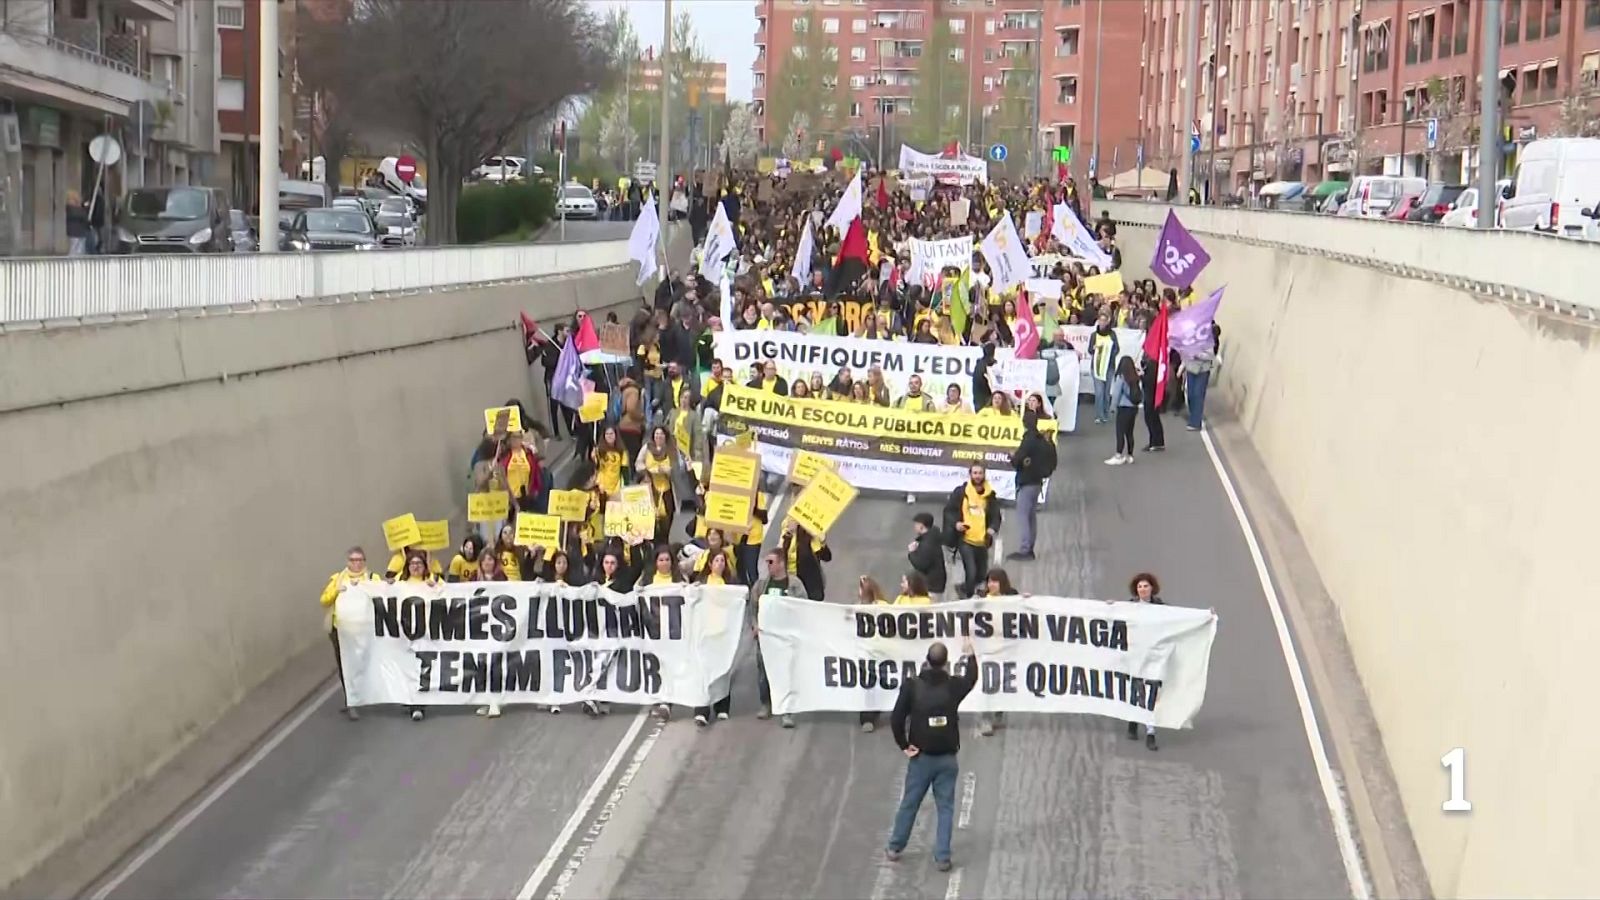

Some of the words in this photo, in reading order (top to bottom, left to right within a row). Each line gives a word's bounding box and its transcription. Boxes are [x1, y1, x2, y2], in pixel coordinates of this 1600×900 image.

[734, 340, 904, 371] DIGNIFIQUEM
[914, 355, 979, 377] L'EDU
[726, 394, 757, 412] PER
[761, 400, 796, 419] UNA
[801, 407, 868, 428] ESCOLA
[950, 423, 971, 438] DE
[977, 425, 1022, 441] QUAL
[902, 446, 944, 457] DIGNITAT
[374, 588, 517, 641] NOMÉS
[528, 595, 685, 641] LLUITANT
[856, 611, 994, 639] DOCENTS
[1002, 612, 1039, 640] EN
[1046, 613, 1128, 651] VAGA
[415, 649, 541, 693] TENIM
[553, 647, 662, 694] FUTUR
[982, 660, 1018, 694] DE
[1026, 661, 1163, 712] QUALITAT
